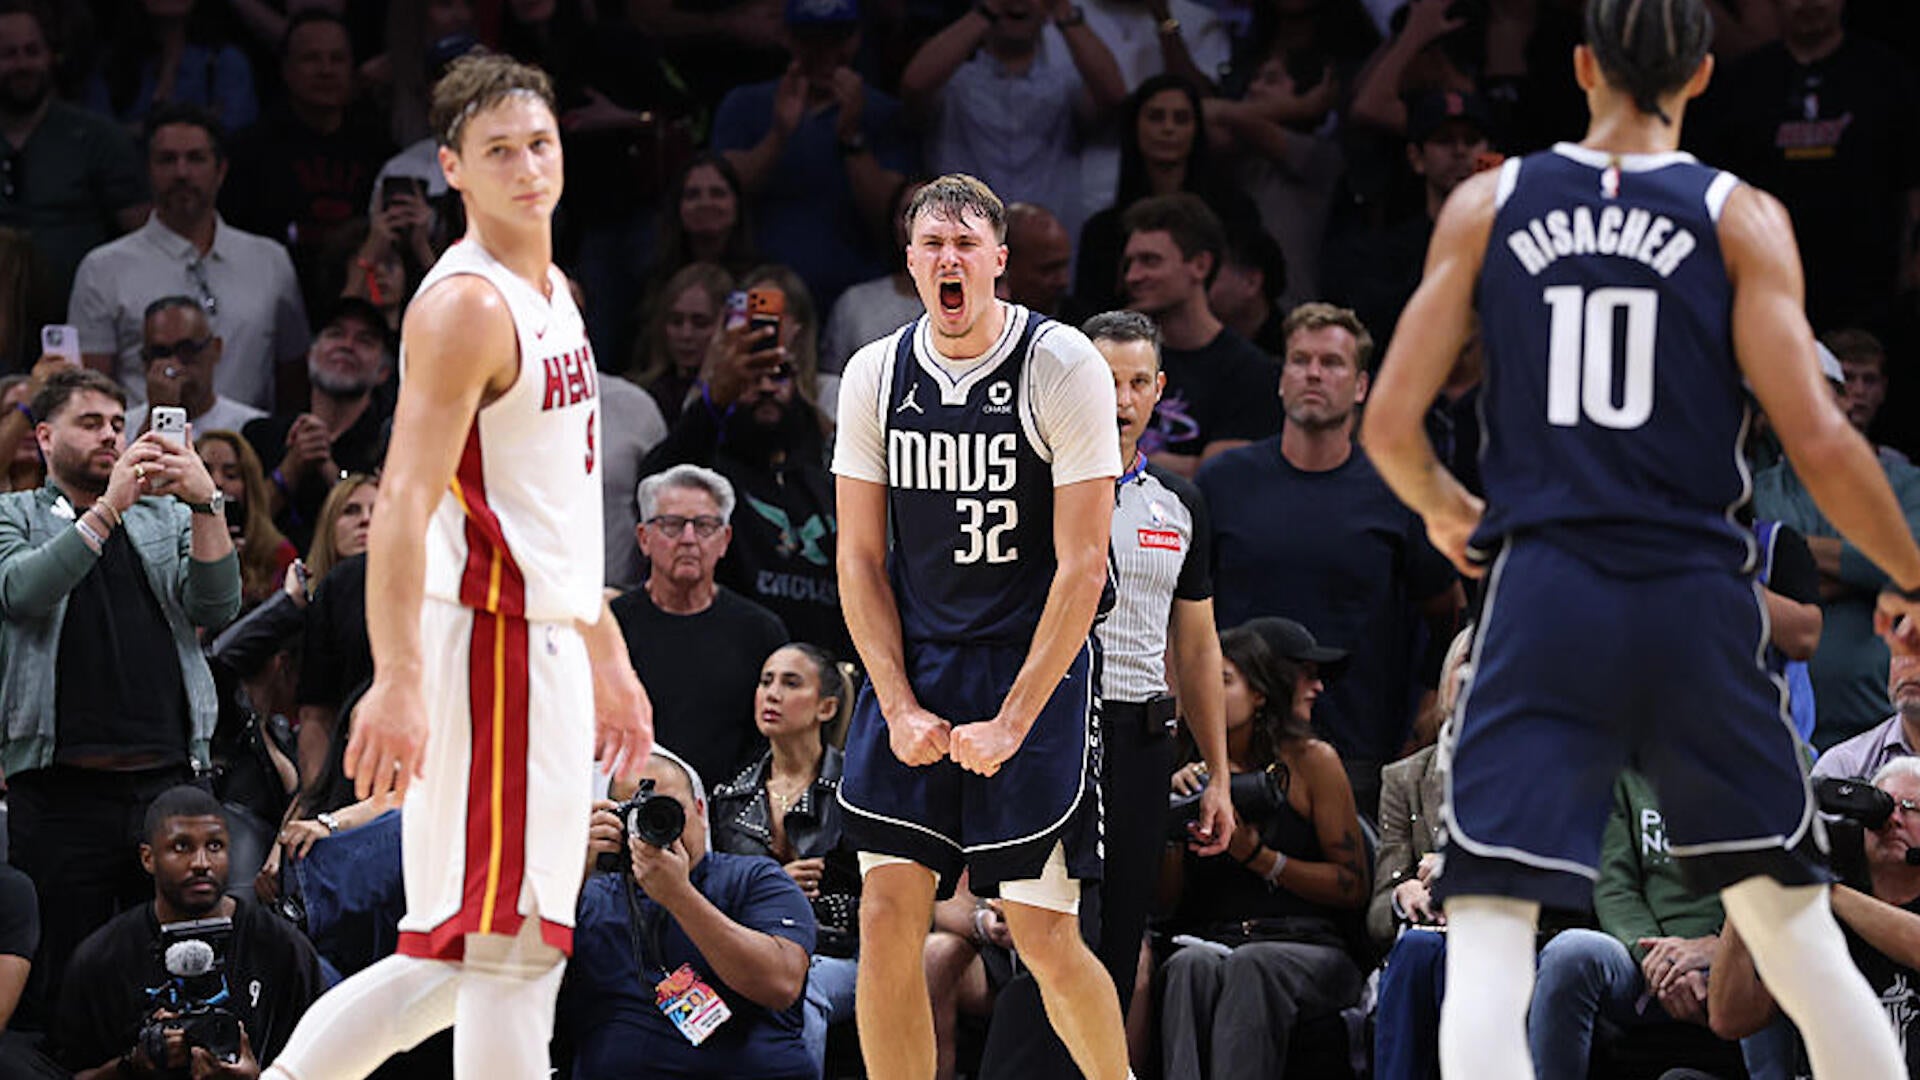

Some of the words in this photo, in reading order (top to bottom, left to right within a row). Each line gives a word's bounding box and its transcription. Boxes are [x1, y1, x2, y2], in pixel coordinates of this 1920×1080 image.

[1508, 206, 1696, 278] RISACHER
[541, 345, 595, 411] HEA
[1543, 285, 1658, 430] 10
[889, 429, 1016, 492] MAVS
[954, 498, 1018, 564] 32
[248, 980, 261, 1007] 9
